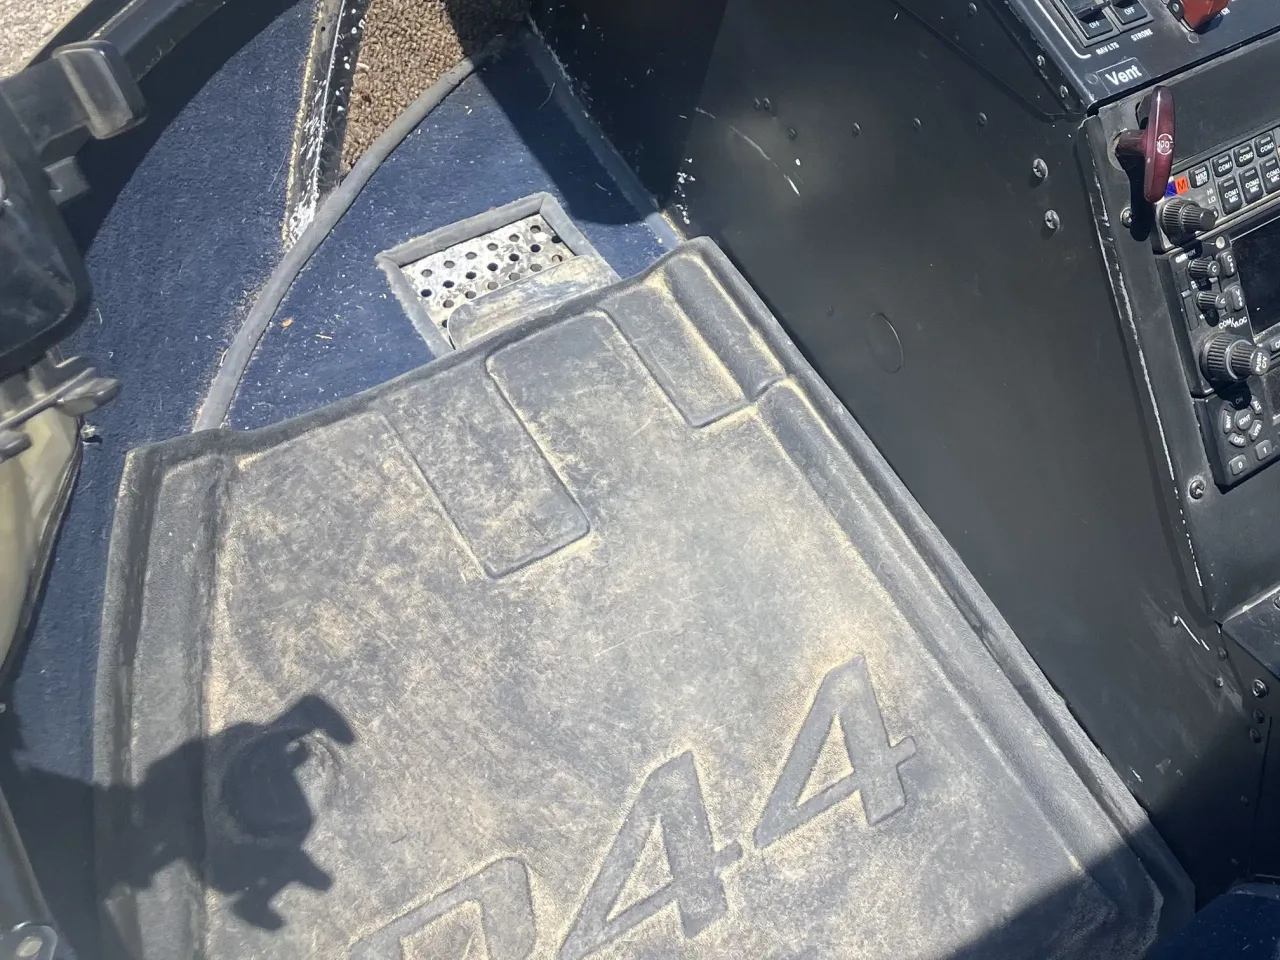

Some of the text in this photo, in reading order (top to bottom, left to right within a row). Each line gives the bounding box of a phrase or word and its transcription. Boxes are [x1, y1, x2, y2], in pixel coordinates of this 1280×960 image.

[1124, 7, 1135, 15] OFF
[1131, 29, 1153, 41] STROBE
[1096, 42, 1119, 55] NAV LTS
[1104, 64, 1142, 86] Vent
[1260, 142, 1275, 153] COM3
[1239, 152, 1254, 163] COM2
[1218, 161, 1233, 173] COM1
[1224, 187, 1239, 199] COM1
[1208, 195, 1216, 204] LO
[1253, 400, 1261, 411] ALT
[1253, 424, 1262, 436] VFR
[1234, 436, 1244, 444] OFF
